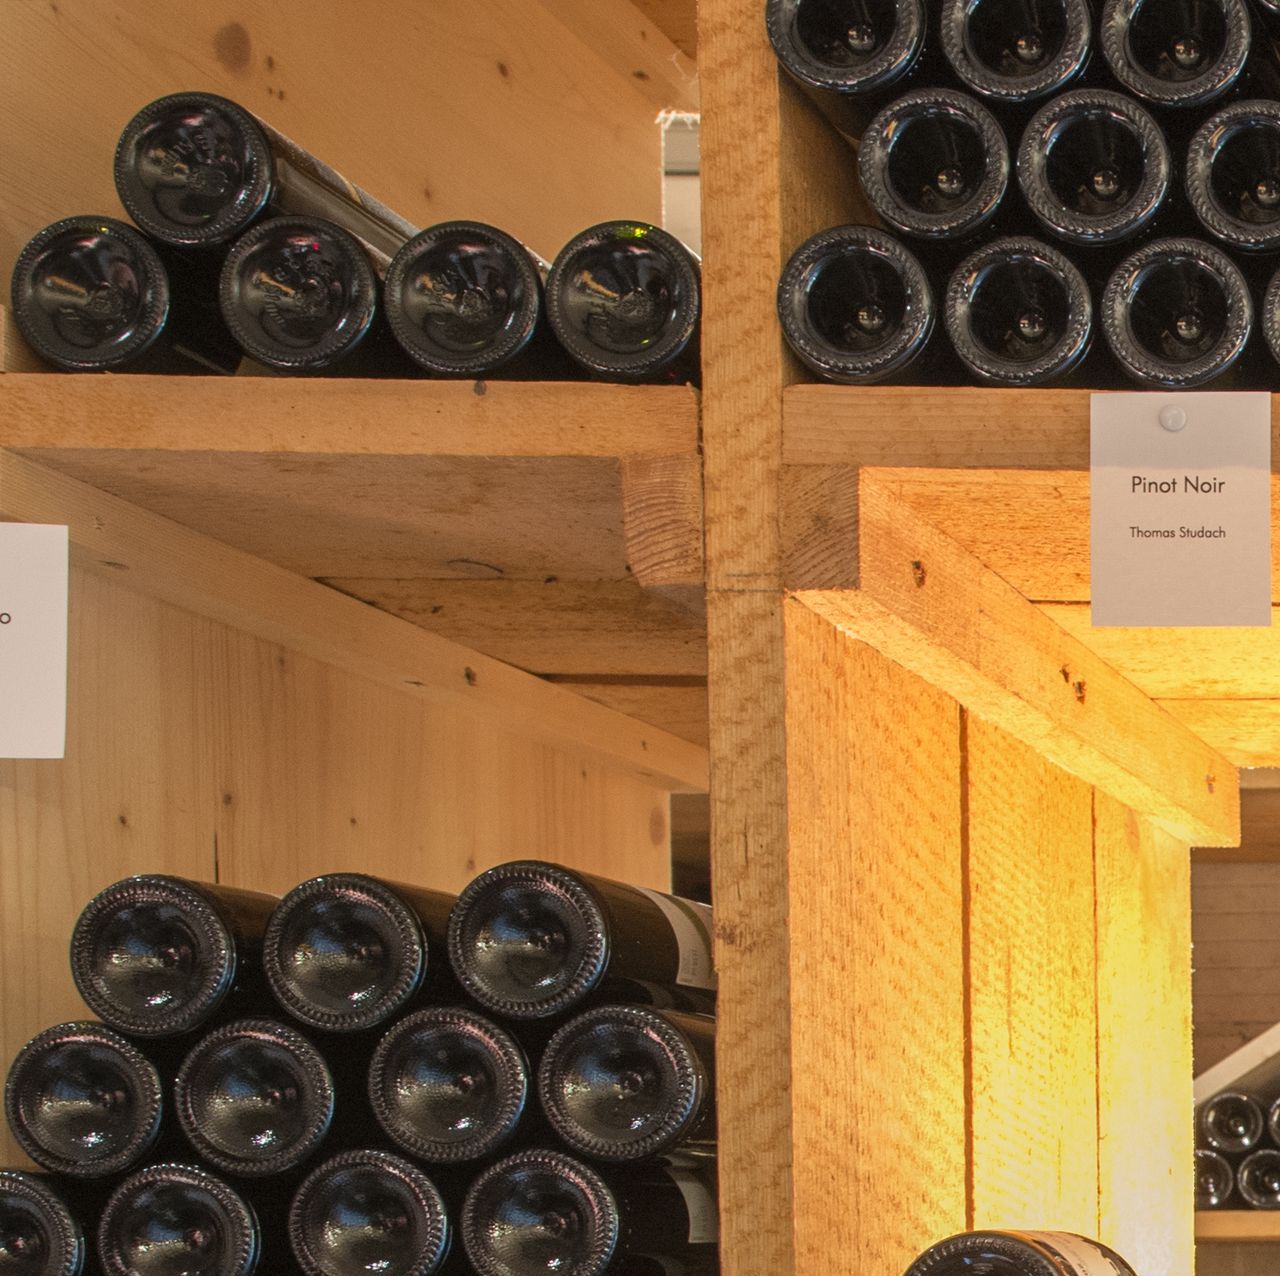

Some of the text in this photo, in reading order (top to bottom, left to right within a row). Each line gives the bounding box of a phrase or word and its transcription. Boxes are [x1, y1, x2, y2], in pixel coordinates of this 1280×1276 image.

[1131, 475, 1226, 494] Pinot Noir
[1129, 526, 1226, 539] Thomas Studach
